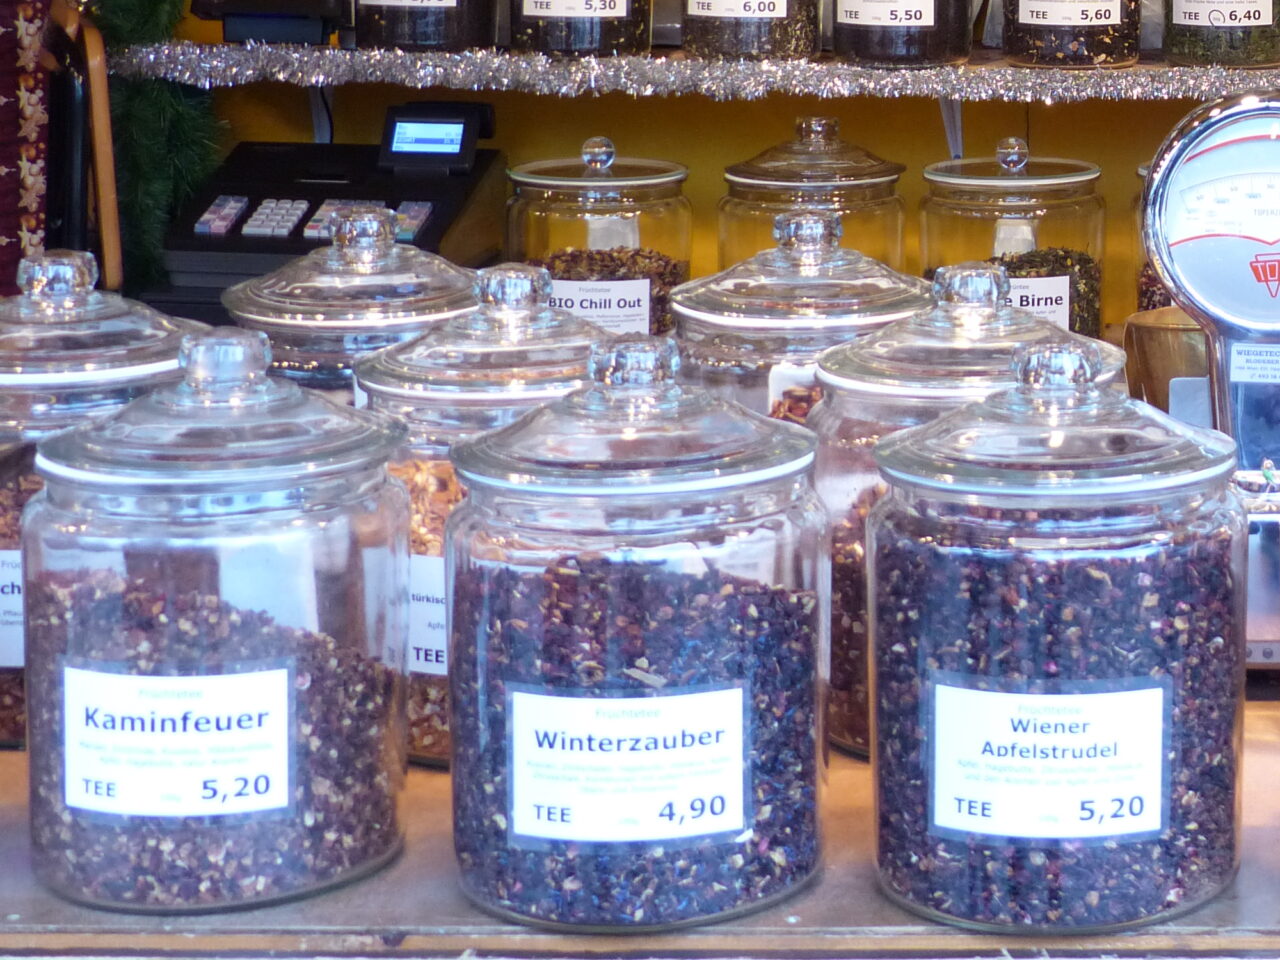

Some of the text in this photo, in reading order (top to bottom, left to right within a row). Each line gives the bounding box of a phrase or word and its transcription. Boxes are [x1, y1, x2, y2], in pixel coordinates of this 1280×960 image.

[533, 0, 617, 13] TEE 5,30
[695, 1, 776, 15] TEE 6,00
[1029, 8, 1112, 23] TEE 5,60
[844, 9, 923, 23] TEE 5,50
[1182, 9, 1262, 24] TEE 6,40
[548, 296, 643, 310] BIO Chill Out
[1019, 293, 1063, 308] Birne
[412, 646, 445, 664] TEE
[84, 706, 269, 733] Kaminfeuer
[1010, 717, 1090, 735] Wiener
[534, 728, 725, 754] Winterzauber
[981, 740, 1118, 760] Apfelstrudel
[82, 773, 271, 804] TEE 5,20
[533, 795, 727, 826] TEE 4,90
[953, 795, 1145, 825] TEE 5,20
